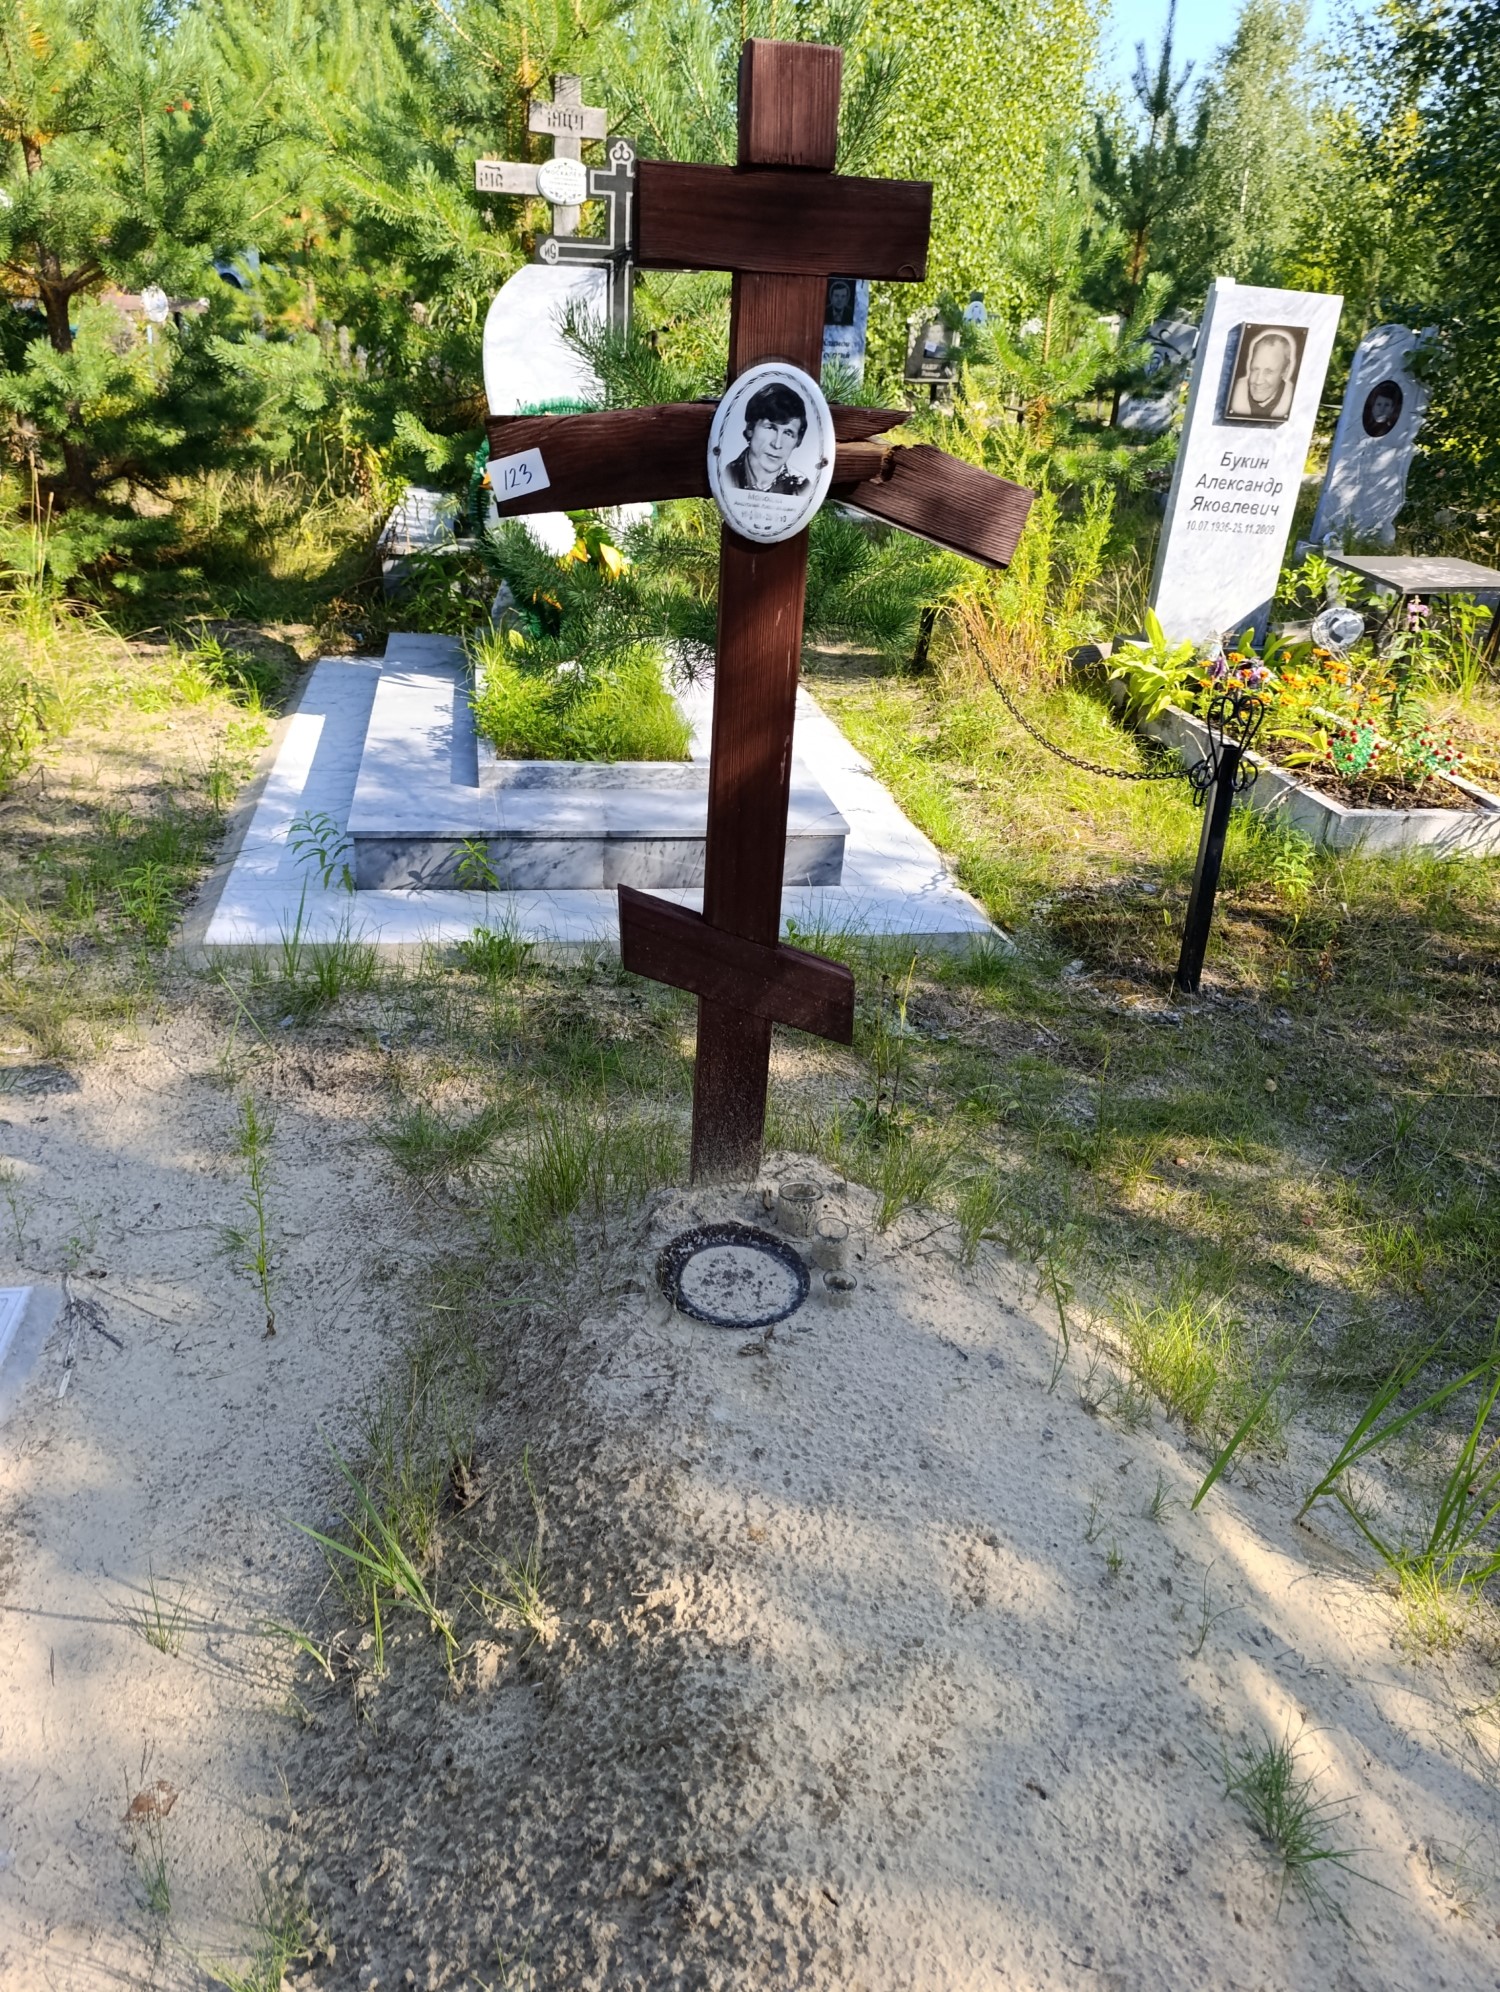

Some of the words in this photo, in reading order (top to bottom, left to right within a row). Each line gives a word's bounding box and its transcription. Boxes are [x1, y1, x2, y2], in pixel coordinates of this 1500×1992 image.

[1220, 451, 1270, 471] Букин
[504, 463, 533, 490] 123
[1195, 473, 1283, 496] Александр
[1190, 496, 1280, 516] Яковлевич
